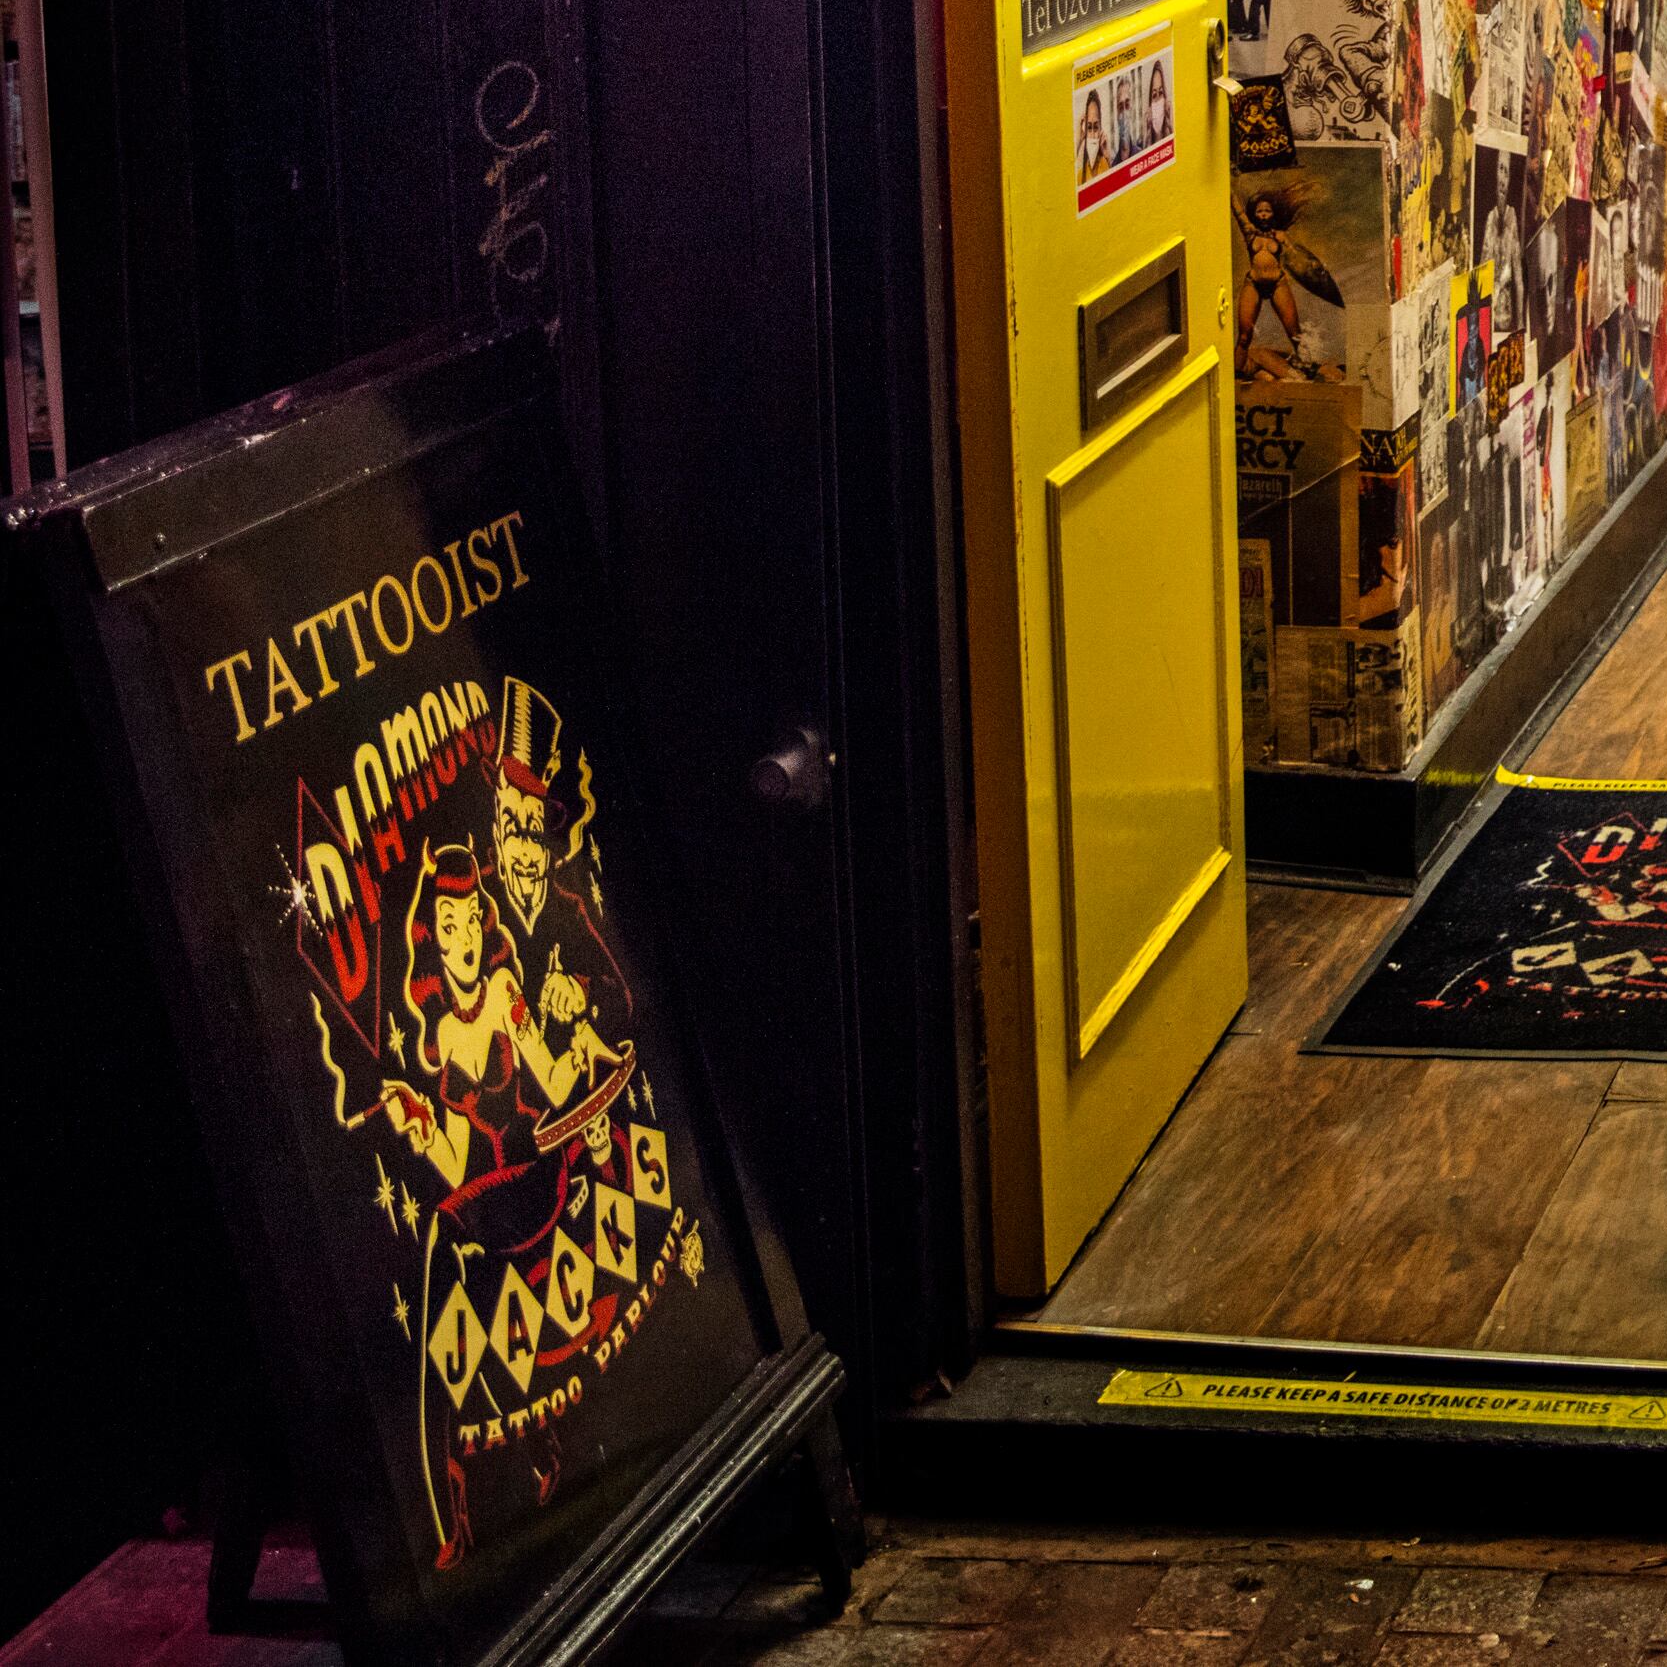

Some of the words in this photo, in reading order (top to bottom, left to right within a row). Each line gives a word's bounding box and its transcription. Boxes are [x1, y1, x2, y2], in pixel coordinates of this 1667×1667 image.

[1077, 68, 1096, 83] PLEASE
[1096, 56, 1117, 74] RESPECT
[1118, 48, 1137, 64] OTHERS
[205, 510, 528, 742] TATTOOIST
[305, 682, 496, 1004] DIAMOND
[459, 1376, 582, 1457] TATTOO
[1203, 1384, 1274, 1400] PLEASE
[1276, 1387, 1327, 1402] KEEP
[1328, 1388, 1340, 1402] A
[1344, 1390, 1392, 1405] SAFE
[1394, 1392, 1487, 1410] DISTANCE
[1489, 1396, 1517, 1410] OF
[1518, 1397, 1530, 1412] 2
[1534, 1399, 1611, 1415] METRES
